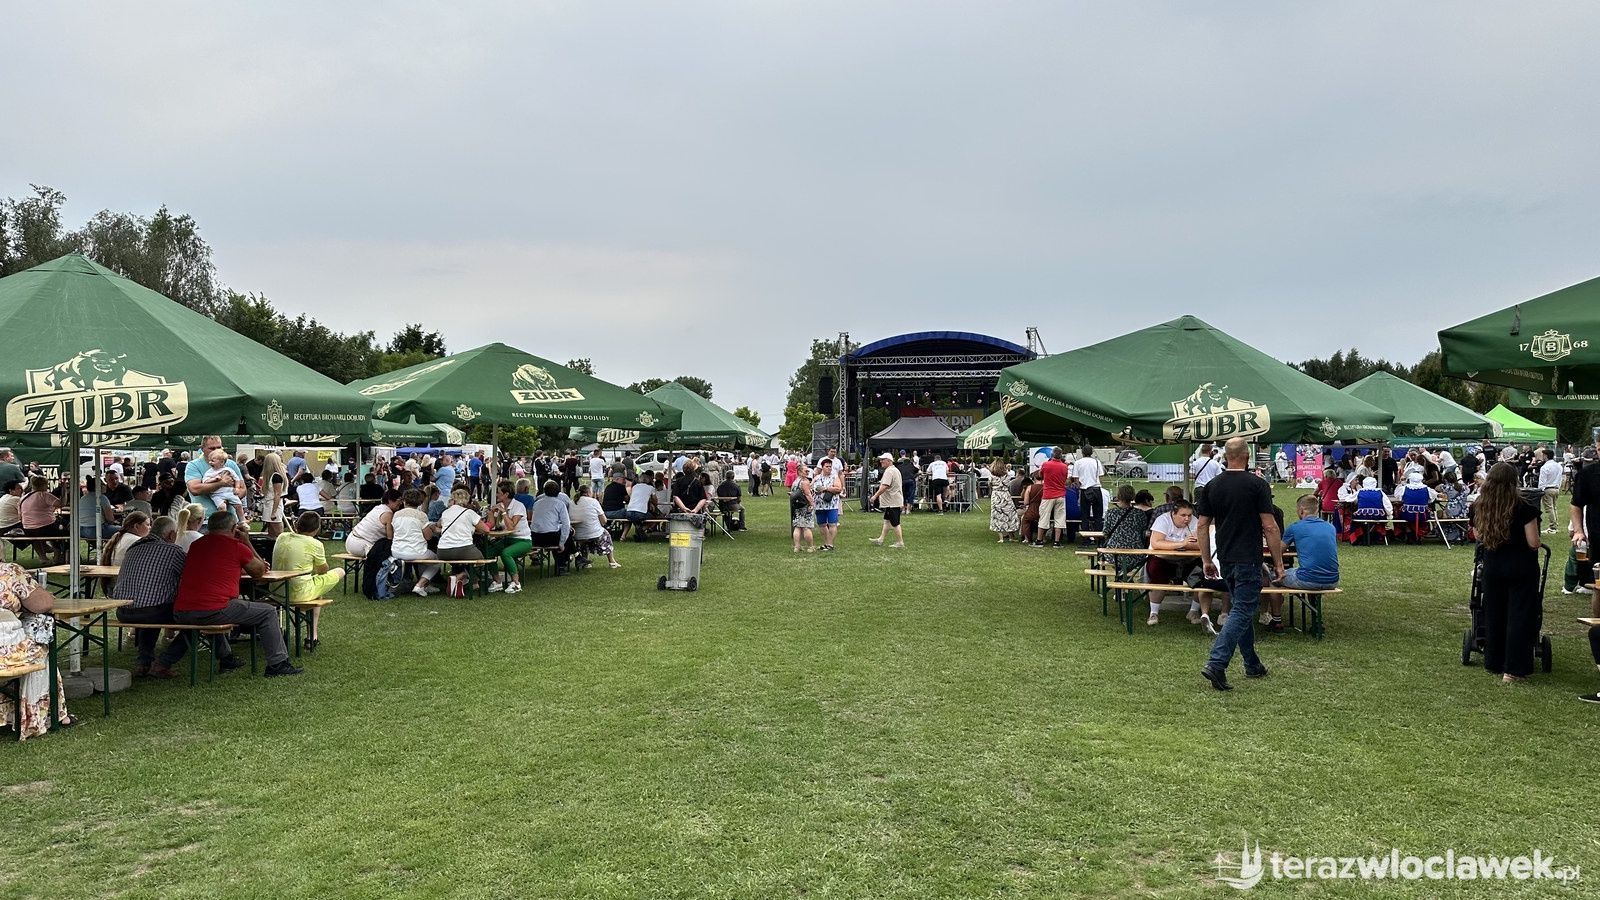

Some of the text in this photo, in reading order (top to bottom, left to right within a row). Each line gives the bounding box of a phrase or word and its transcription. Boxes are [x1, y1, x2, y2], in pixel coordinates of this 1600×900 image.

[1519, 343, 1529, 351] 17
[1573, 340, 1588, 348] 68
[951, 415, 973, 426] DNI
